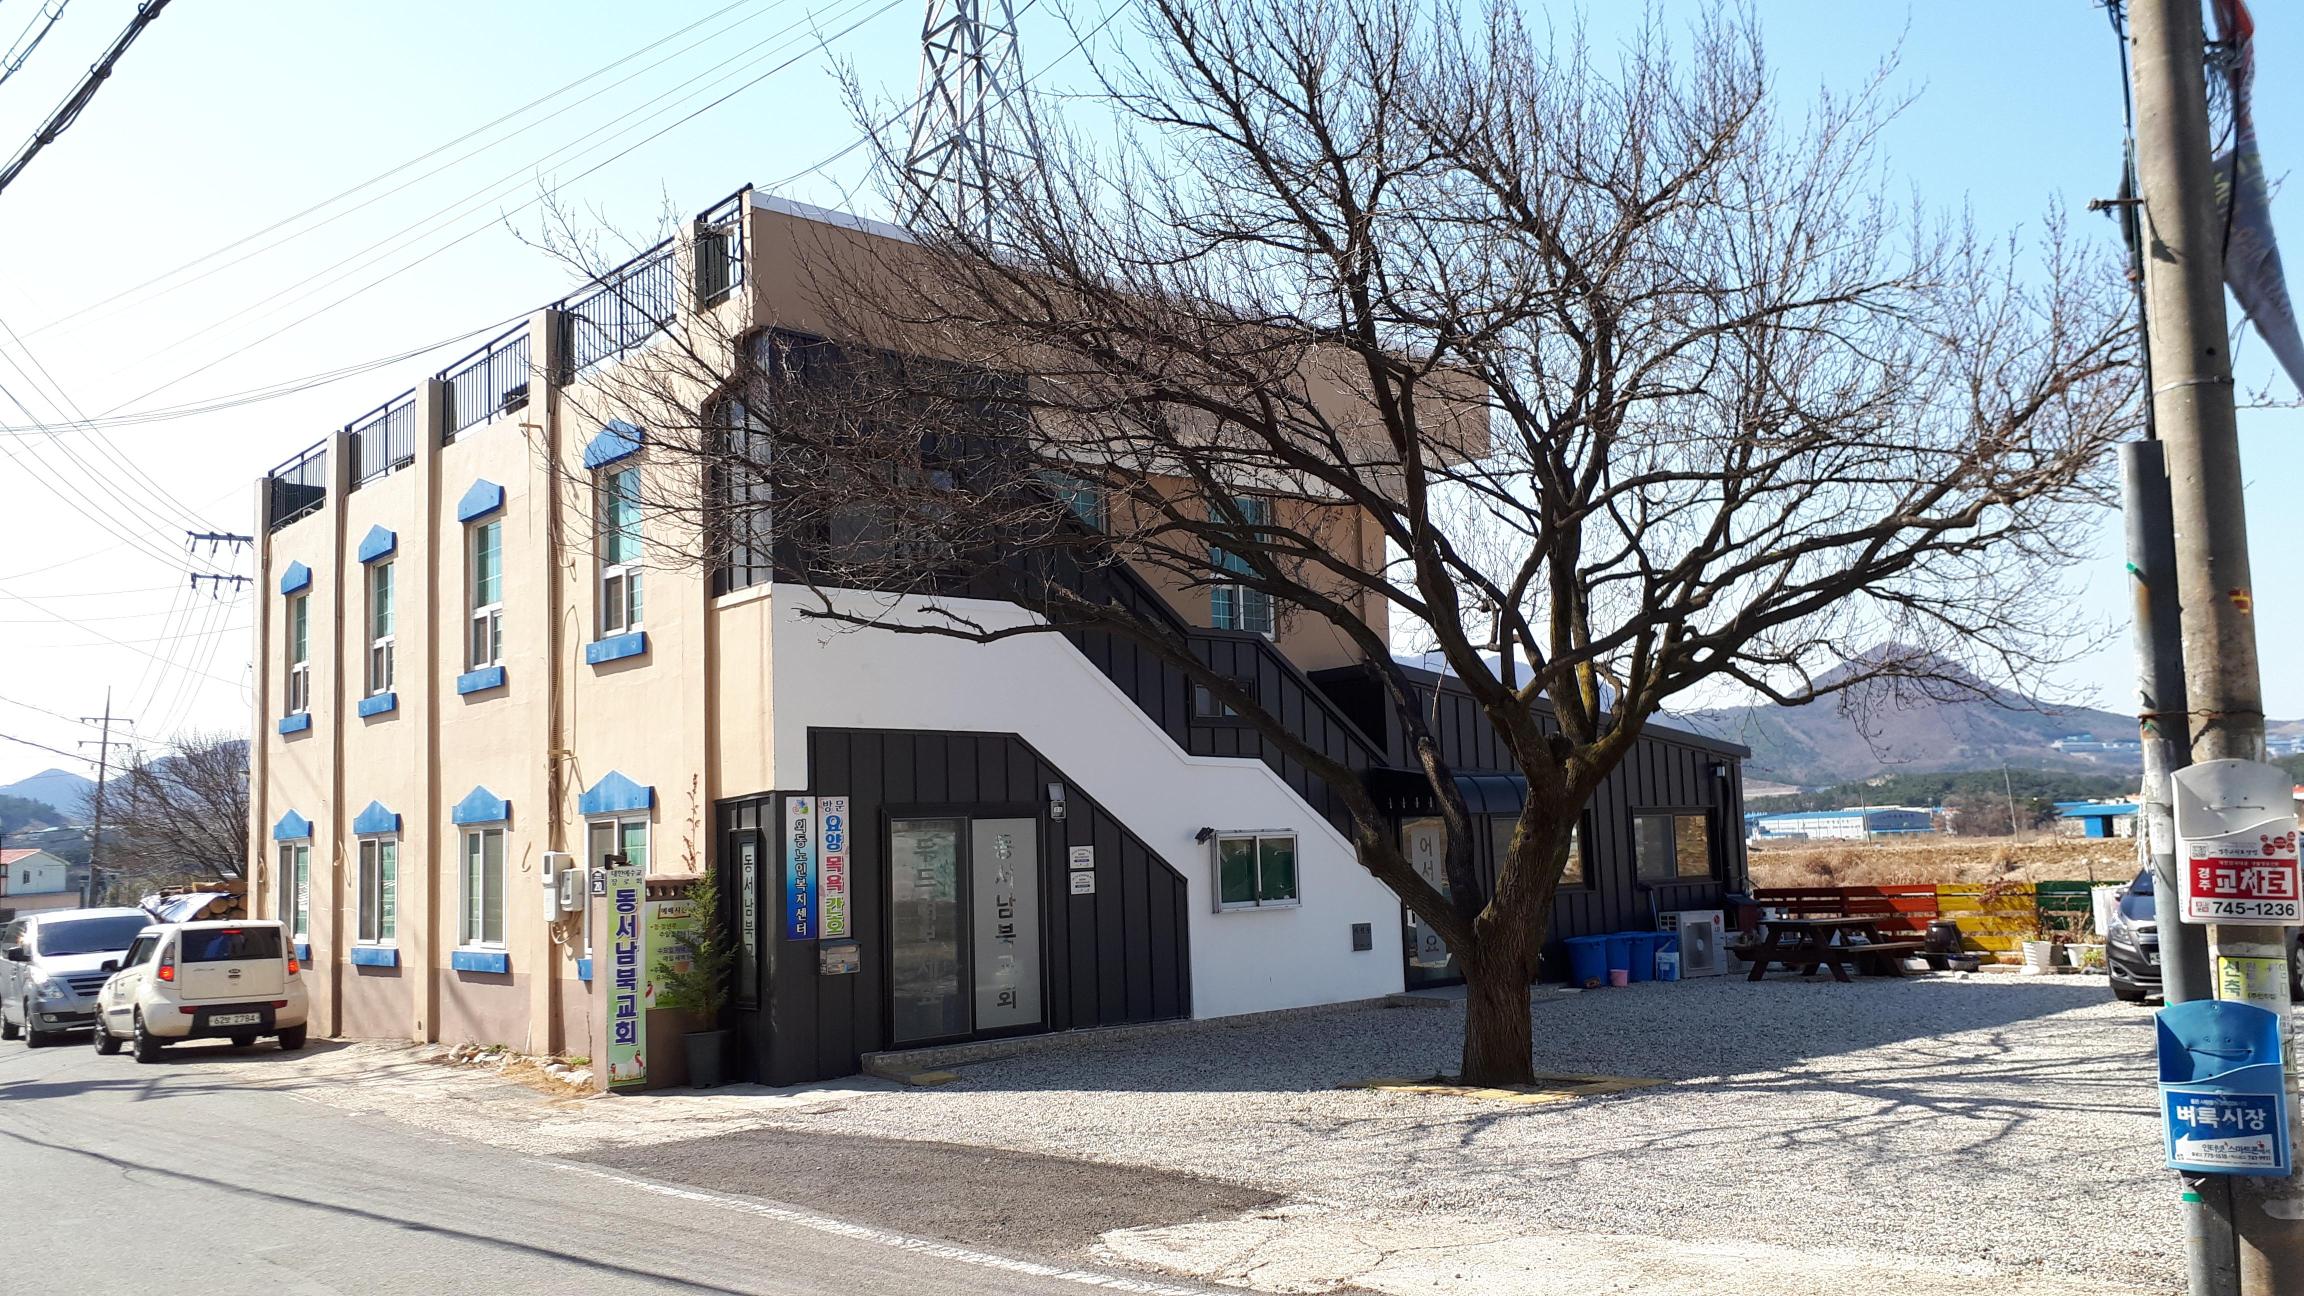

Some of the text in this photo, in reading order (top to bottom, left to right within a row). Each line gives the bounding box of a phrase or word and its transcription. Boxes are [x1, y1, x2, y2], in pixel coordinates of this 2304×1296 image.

[822, 799, 846, 813] 방문
[593, 881, 602, 891] 20
[794, 818, 808, 936] 외동노인복지센터
[825, 815, 845, 936] 요양 목욕 간호
[2197, 867, 2212, 891] 경주
[2214, 867, 2293, 897] 교차로
[2213, 902, 2295, 916] 745-1236
[615, 888, 639, 1045] 동서남북교회
[2223, 960, 2241, 997] 신축
[2176, 1105, 2267, 1130] 벼룩시장
